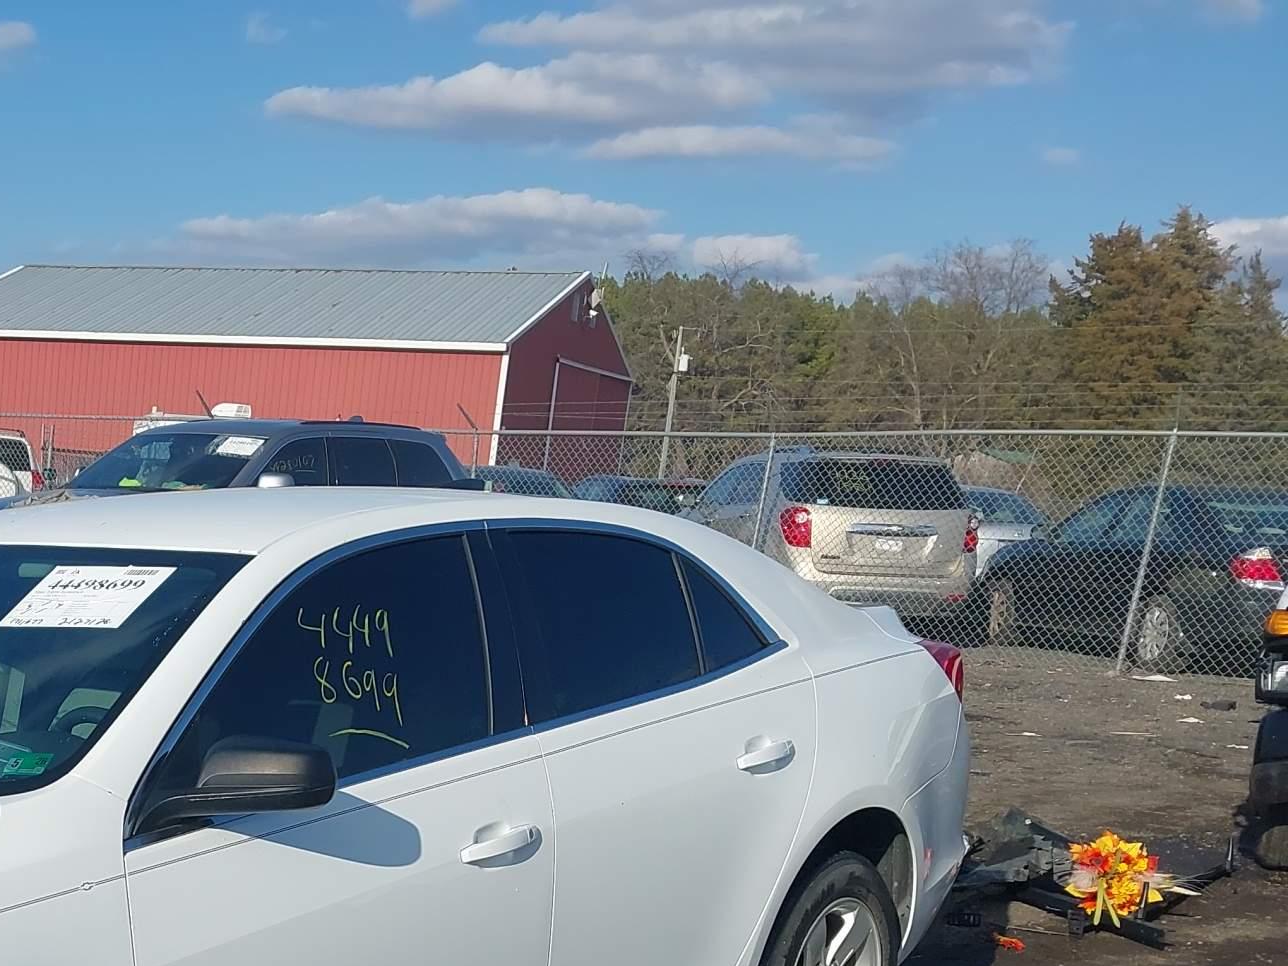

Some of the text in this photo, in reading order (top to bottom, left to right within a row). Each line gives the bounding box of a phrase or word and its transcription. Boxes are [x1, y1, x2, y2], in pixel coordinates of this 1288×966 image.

[48, 578, 146, 591] 44498699
[297, 604, 394, 657] 4449
[313, 656, 403, 727] 8699
